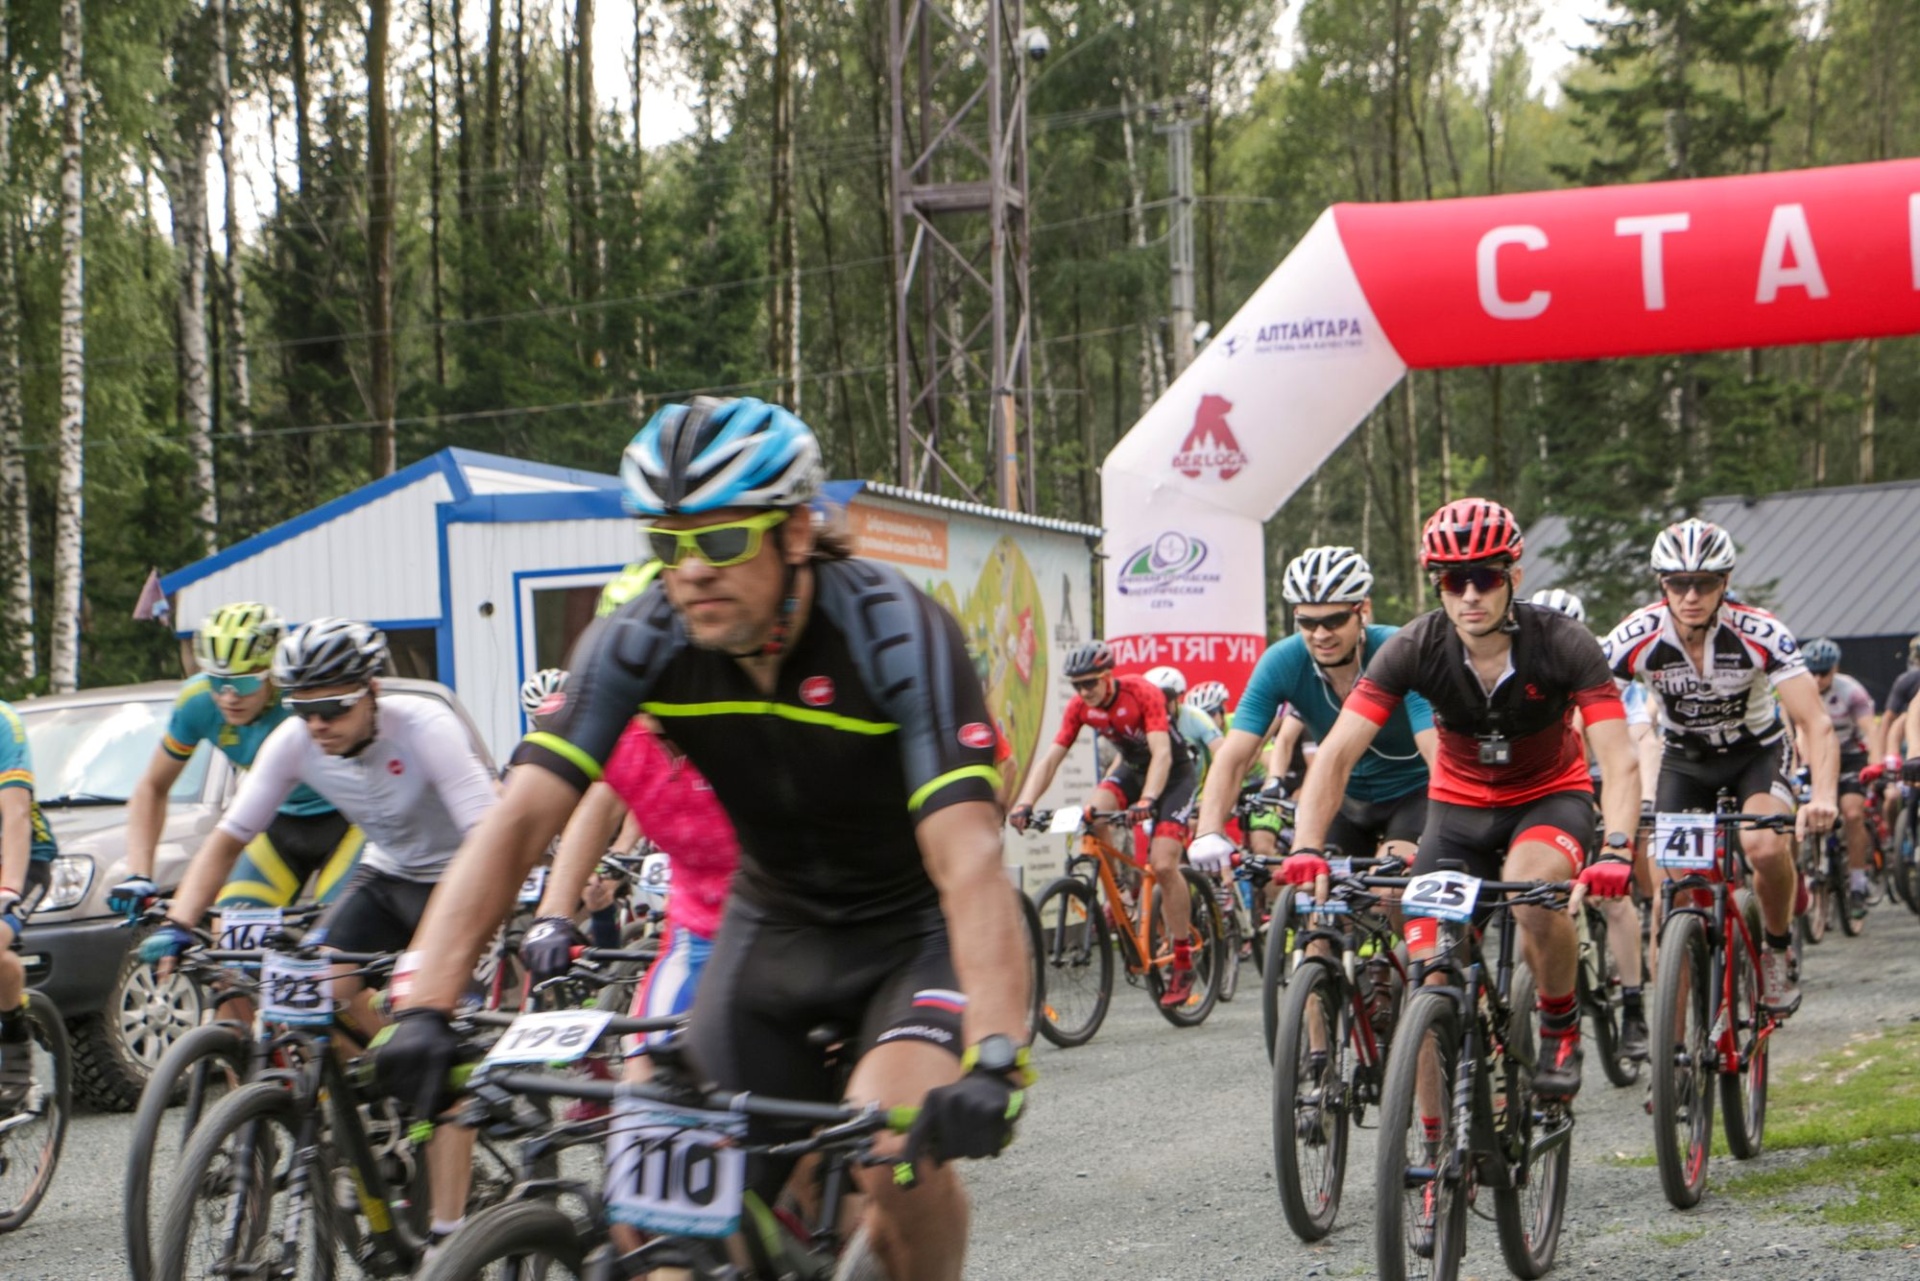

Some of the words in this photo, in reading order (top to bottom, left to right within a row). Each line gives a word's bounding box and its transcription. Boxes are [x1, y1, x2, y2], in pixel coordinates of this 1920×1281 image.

[1476, 192, 1920, 320] СТА
[1257, 317, 1362, 342] АЛТАЙТАРА
[1112, 632, 1256, 666] ТАЙ-ТЯГУН
[1665, 826, 1704, 857] 41
[1411, 880, 1467, 906] 25
[506, 1025, 587, 1051] 198
[626, 1134, 717, 1207] 110
